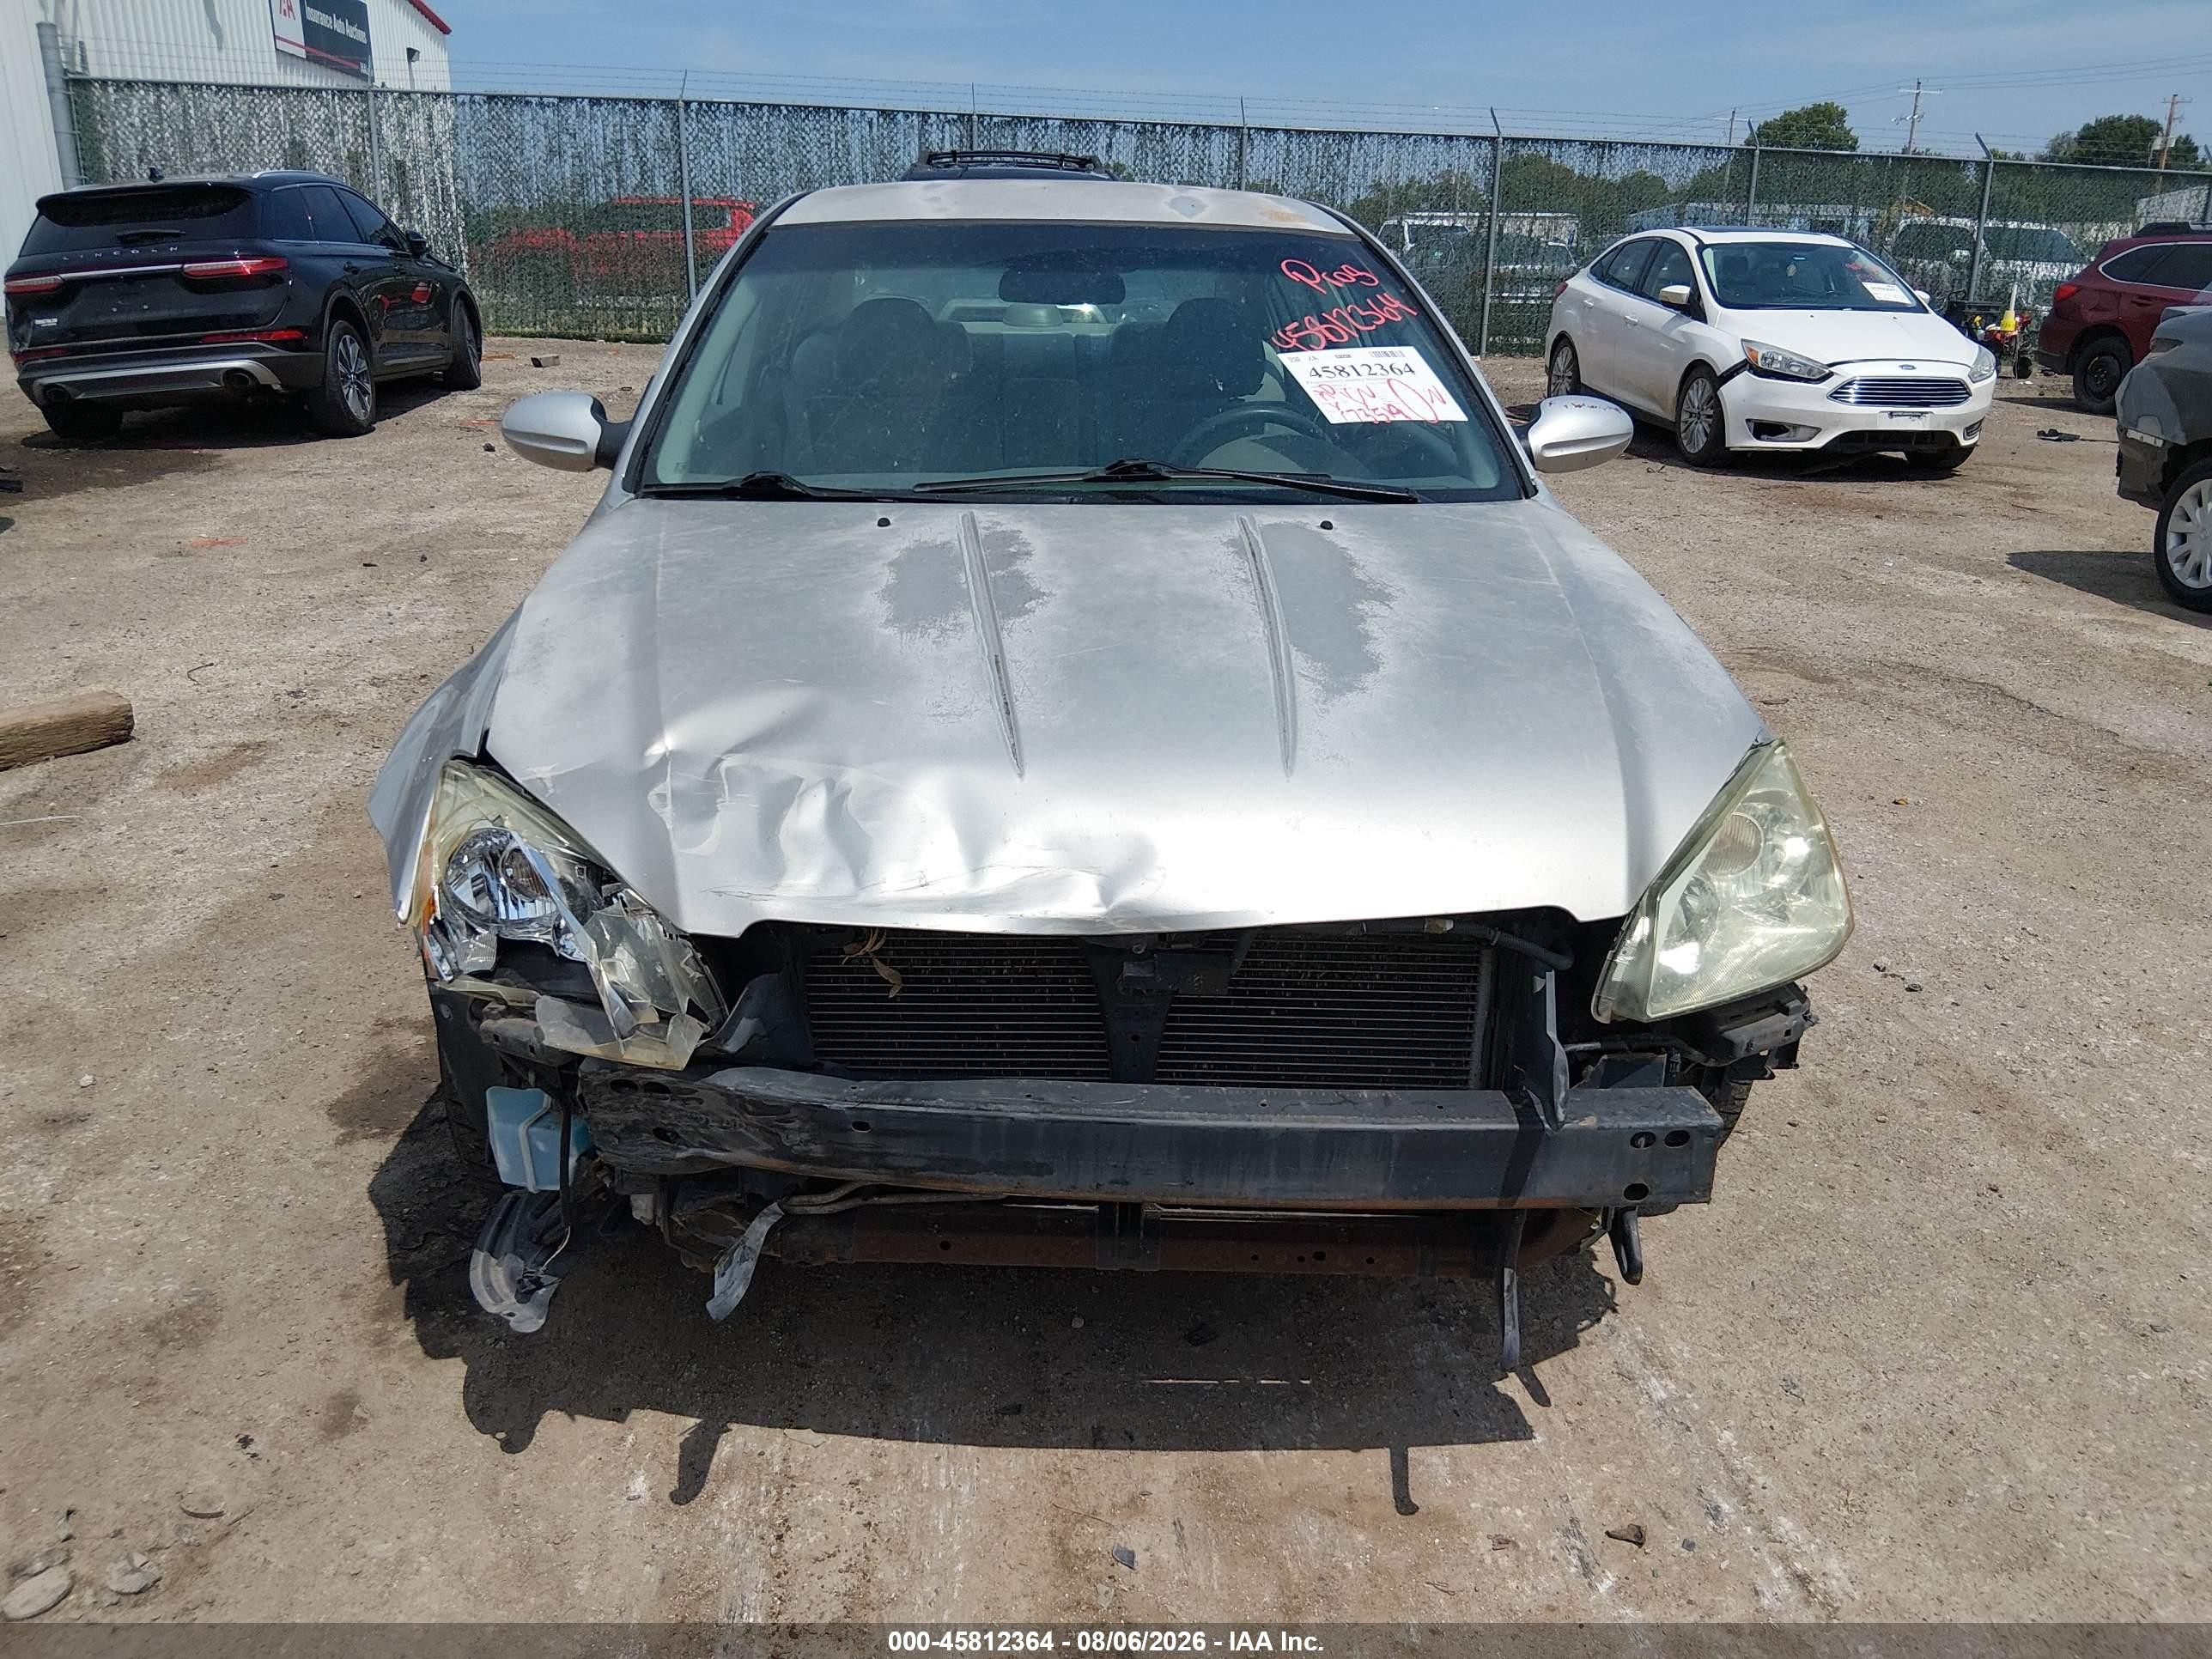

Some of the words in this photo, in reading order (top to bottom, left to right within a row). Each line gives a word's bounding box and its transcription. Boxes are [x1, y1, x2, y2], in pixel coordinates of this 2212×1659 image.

[304, 0, 333, 30] Insurance
[332, 13, 346, 35] Auto
[345, 18, 368, 45] Auctions
[63, 246, 179, 261] LINCOLN
[1272, 292, 1419, 352] 45812364
[1310, 362, 1416, 380] 45812364
